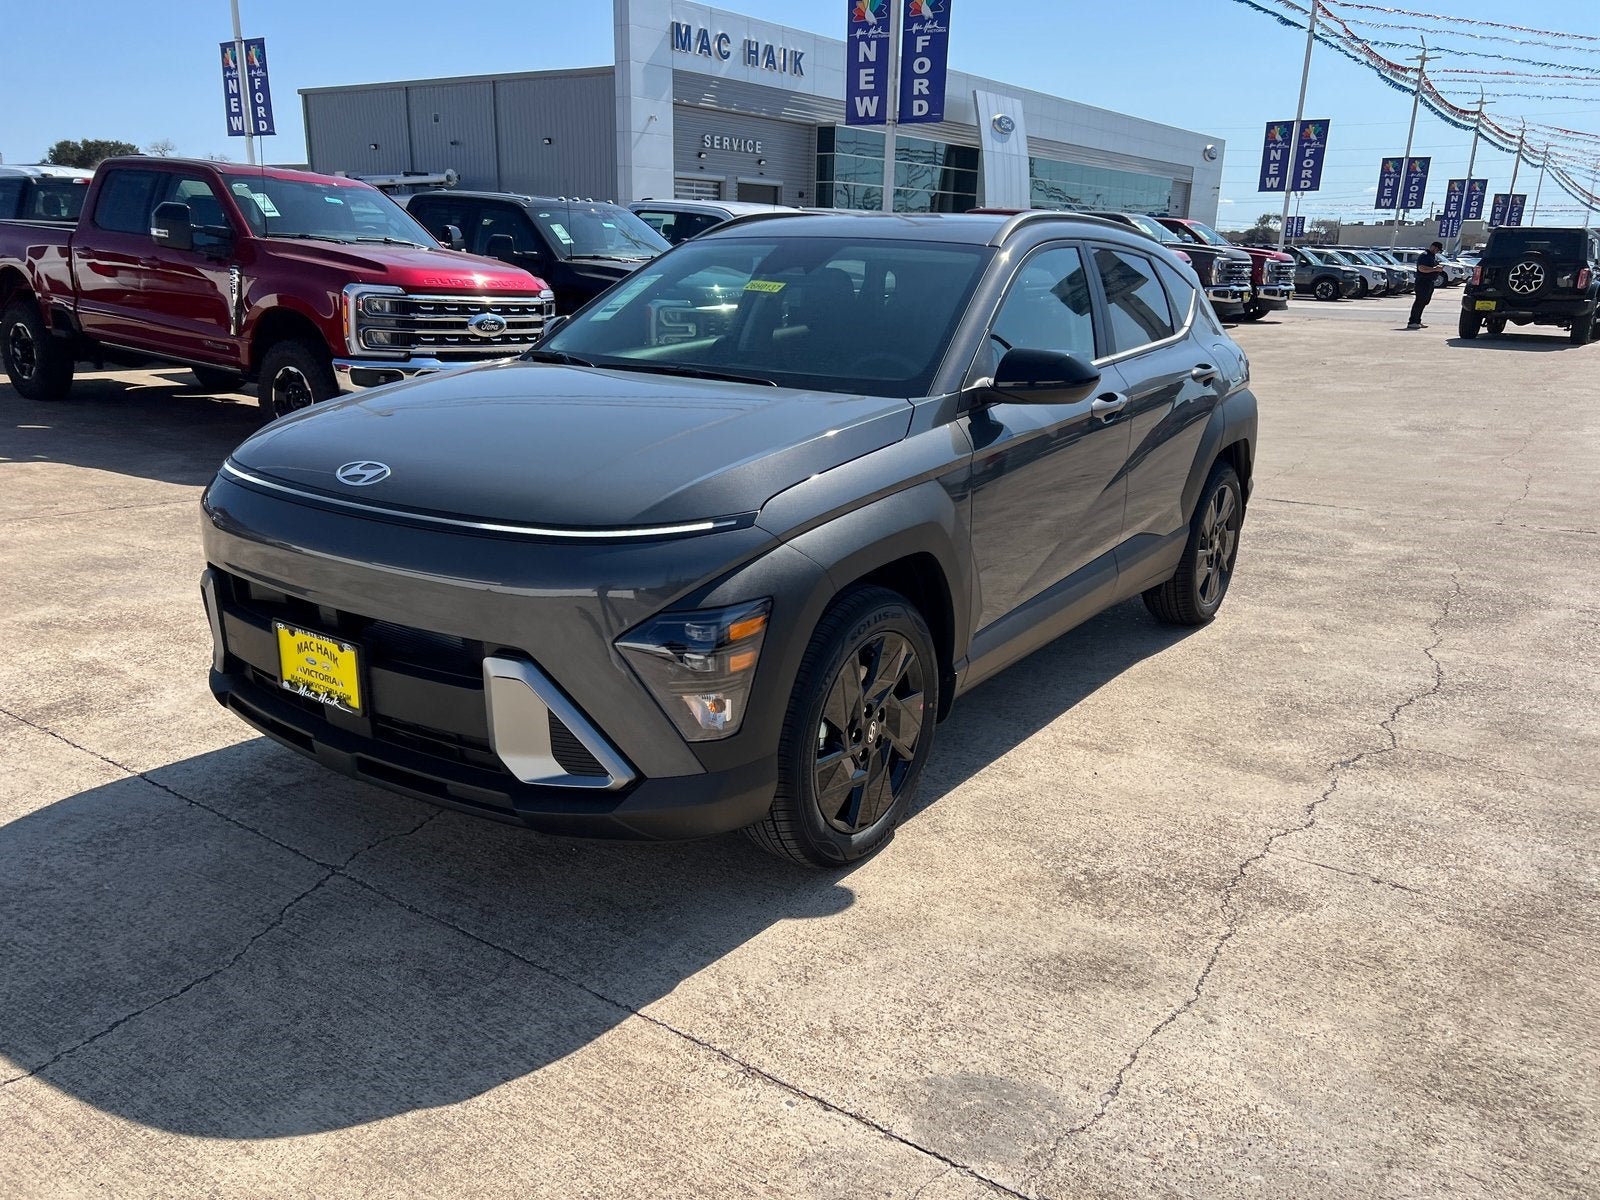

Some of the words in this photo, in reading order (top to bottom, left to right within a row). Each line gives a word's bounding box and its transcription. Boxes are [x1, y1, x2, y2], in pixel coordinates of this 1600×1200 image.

[671, 20, 731, 61] MAC
[744, 38, 805, 77] HAIK
[855, 40, 879, 117] NEW
[912, 35, 931, 116] FORD
[228, 79, 242, 131] NEW
[254, 78, 268, 132] FORD
[704, 134, 762, 153] SERVICE
[1265, 149, 1282, 188] NEW
[1300, 148, 1315, 189] FORD
[1380, 178, 1394, 207] NEW
[1407, 177, 1420, 207] FORD
[1447, 195, 1458, 218] NEW
[1469, 195, 1479, 218] FORD
[1492, 207, 1502, 226] NEW
[1510, 207, 1519, 226] FORD
[481, 319, 499, 331] Ford
[297, 641, 315, 655] MAC
[316, 643, 339, 668] HAIK
[302, 666, 337, 685] VICTORIA
[298, 684, 316, 698] Mac
